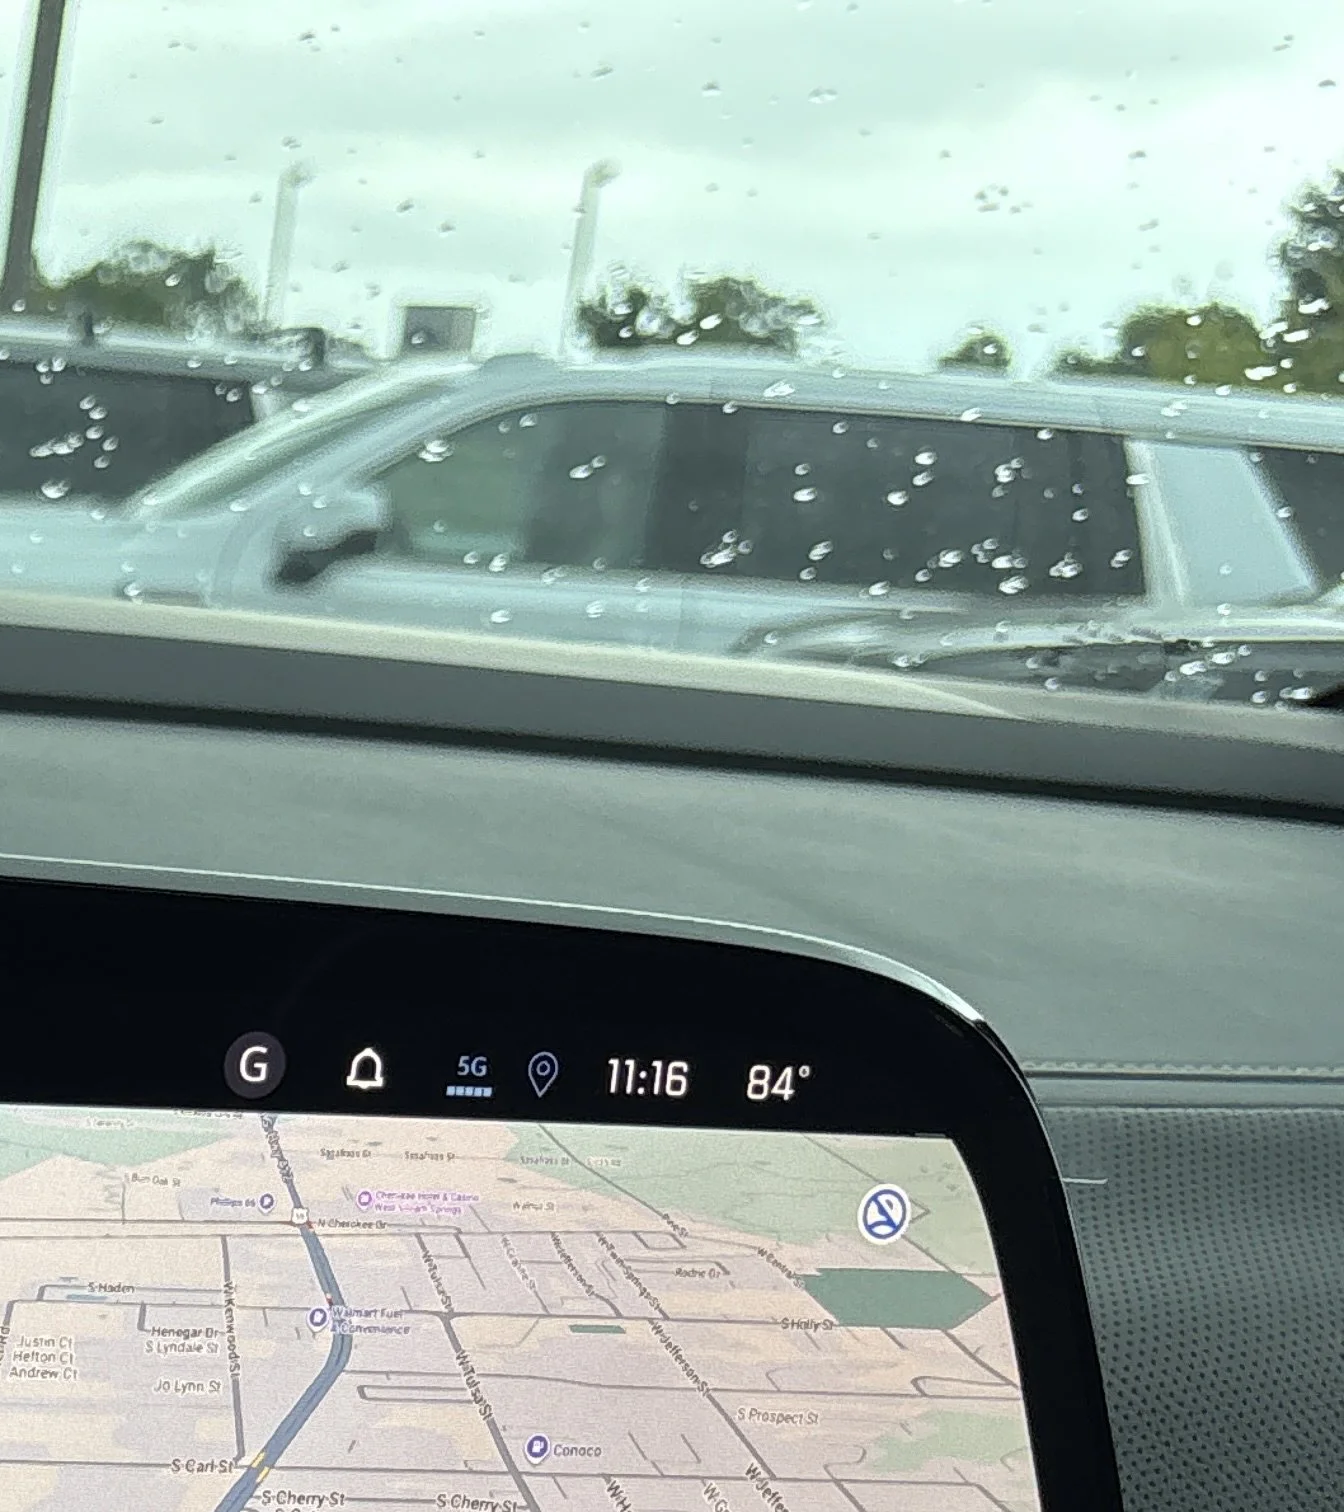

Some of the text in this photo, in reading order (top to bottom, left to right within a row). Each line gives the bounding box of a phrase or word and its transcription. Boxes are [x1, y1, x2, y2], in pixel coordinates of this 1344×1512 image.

[239, 1046, 268, 1082] G
[457, 1055, 487, 1077] 5G
[608, 1058, 688, 1097] 11:16
[746, 1064, 810, 1100] 84°
[553, 1444, 602, 1457] Conoco
[703, 1483, 718, 1501] W
